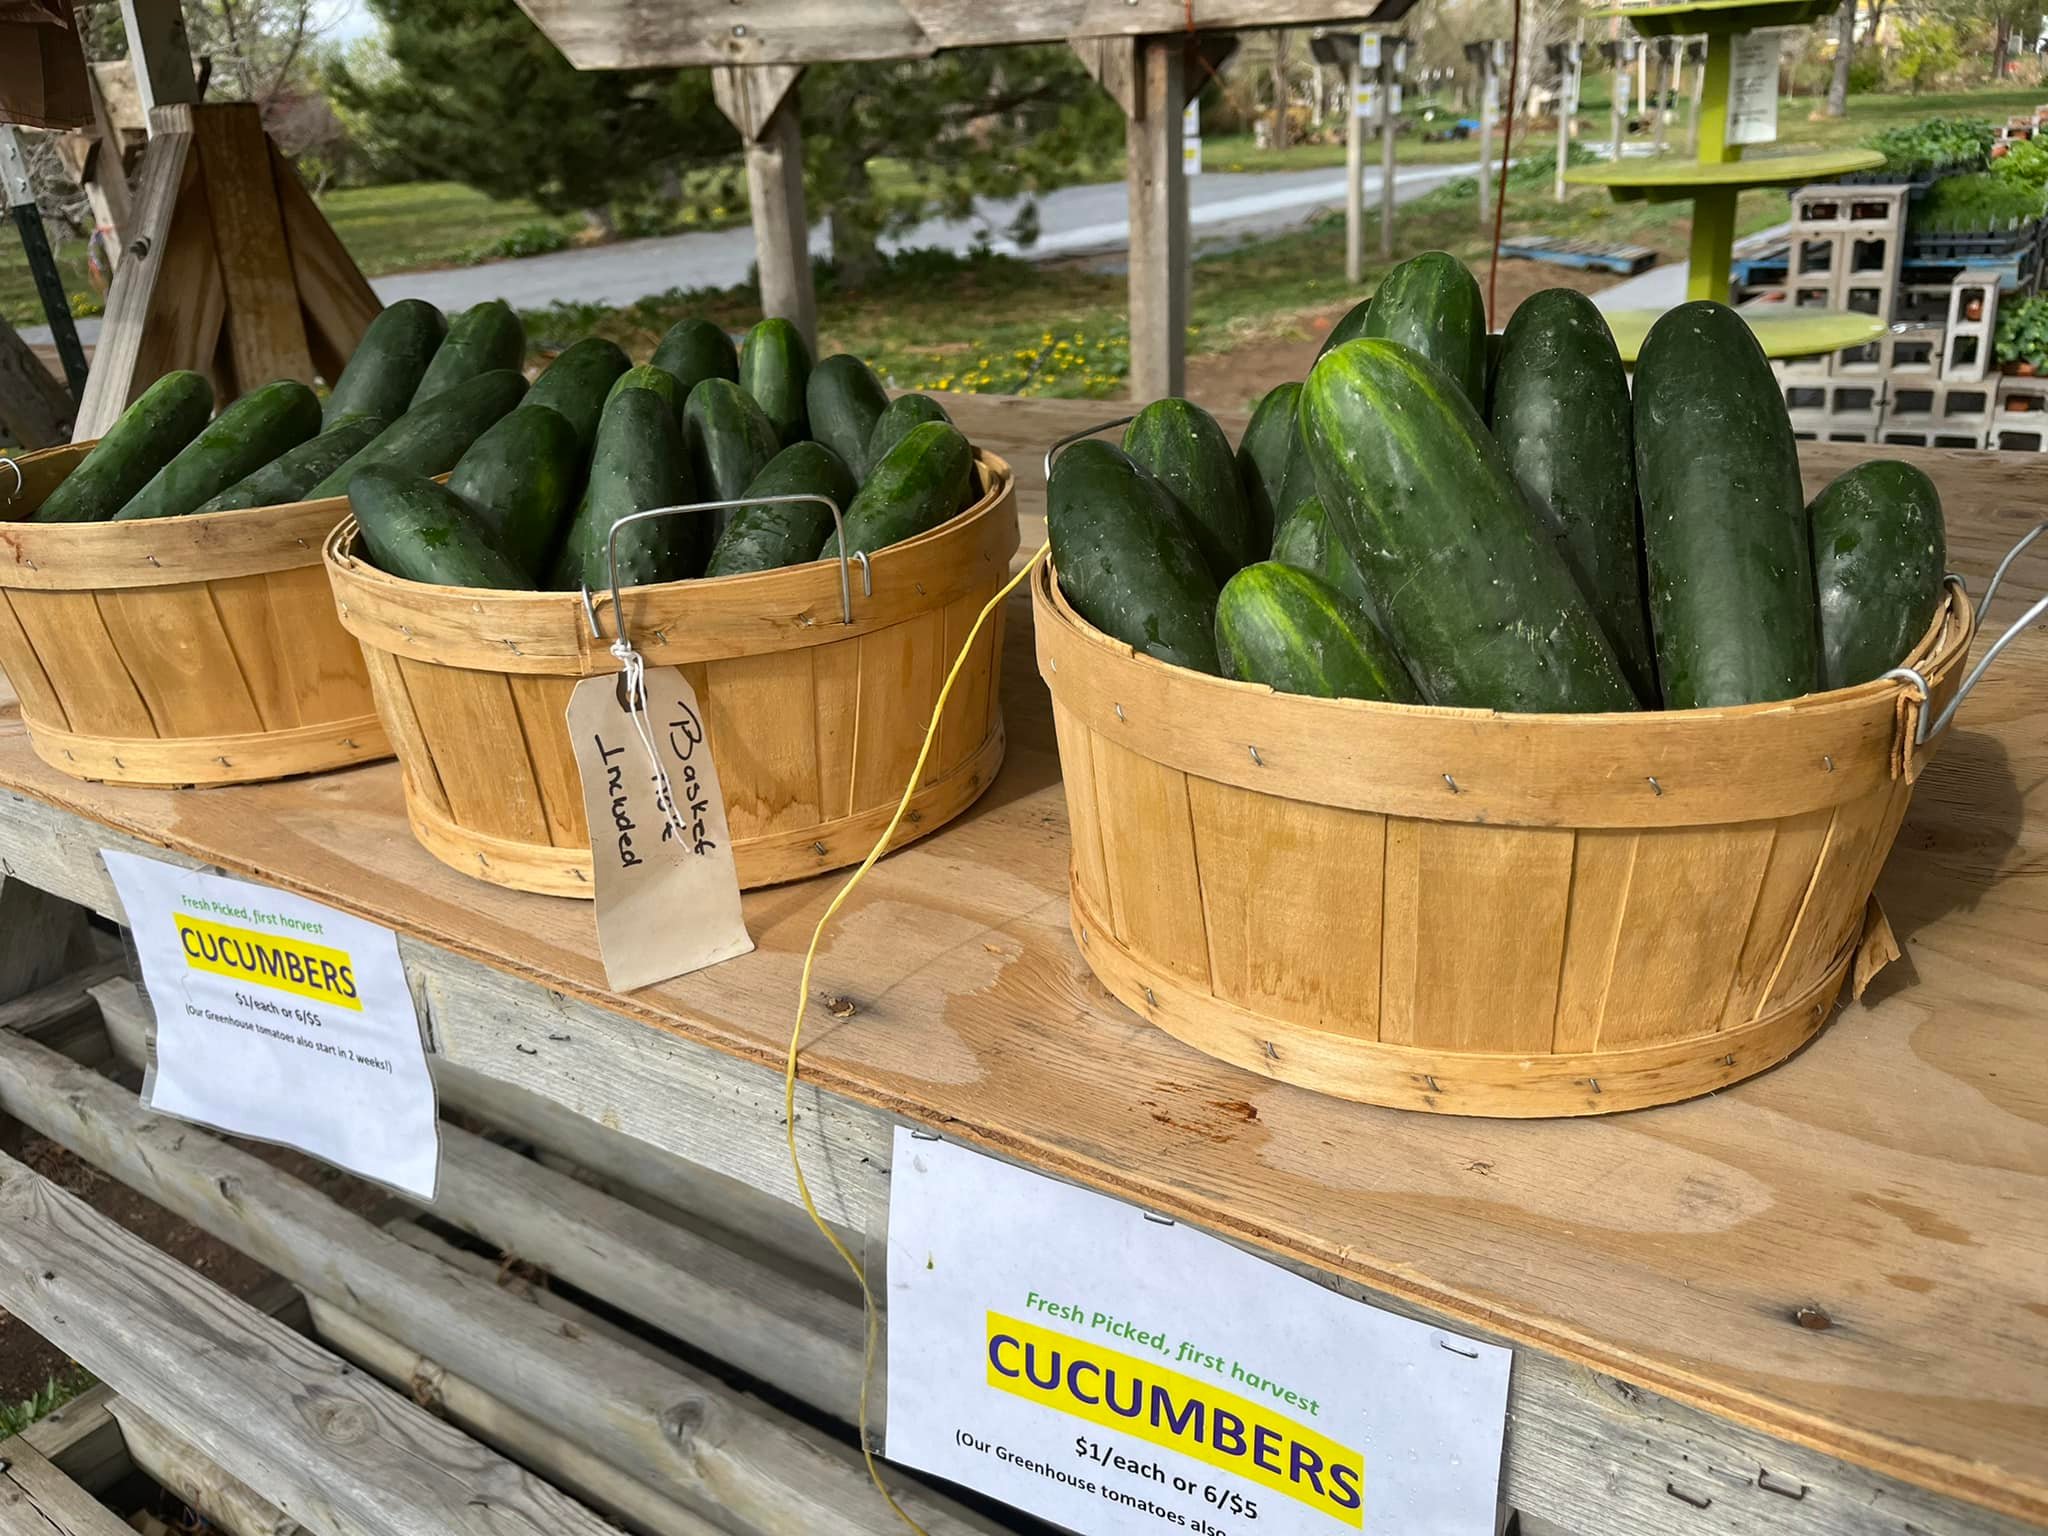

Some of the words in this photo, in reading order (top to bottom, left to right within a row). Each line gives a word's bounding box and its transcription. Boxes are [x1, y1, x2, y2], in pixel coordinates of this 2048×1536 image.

[594, 734, 642, 868] Included
[668, 701, 716, 856] Basket
[181, 894, 211, 911] Fresh
[211, 901, 252, 922] Picked,
[253, 909, 279, 925] first
[280, 913, 325, 935] harvest
[181, 927, 357, 998] CUCUMBERS
[235, 992, 280, 1016] $1/each
[281, 1008, 293, 1019] or
[294, 1009, 322, 1027] 6/$5
[185, 1003, 203, 1016] (Our
[205, 1009, 254, 1032] Greenhouse
[255, 1023, 295, 1043] tomatoes
[296, 1035, 314, 1049] also
[315, 1042, 337, 1056] start
[337, 1046, 347, 1059] in
[348, 1050, 355, 1061] 2
[356, 1055, 393, 1075] weeks!)
[1026, 1291, 1085, 1324] Fresh
[1091, 1312, 1171, 1355] Picked,
[1175, 1342, 1225, 1373] first
[1231, 1362, 1321, 1416] harvest
[988, 1334, 1361, 1509] CUCUMBERS
[956, 1429, 991, 1453] (Our
[995, 1446, 1096, 1494] Greenhouse
[1101, 1485, 1185, 1526] tomatoes
[1190, 1519, 1227, 1536] also
[1075, 1436, 1165, 1483] $1/each
[1172, 1476, 1198, 1495] or
[1203, 1485, 1259, 1519] 6/$5
